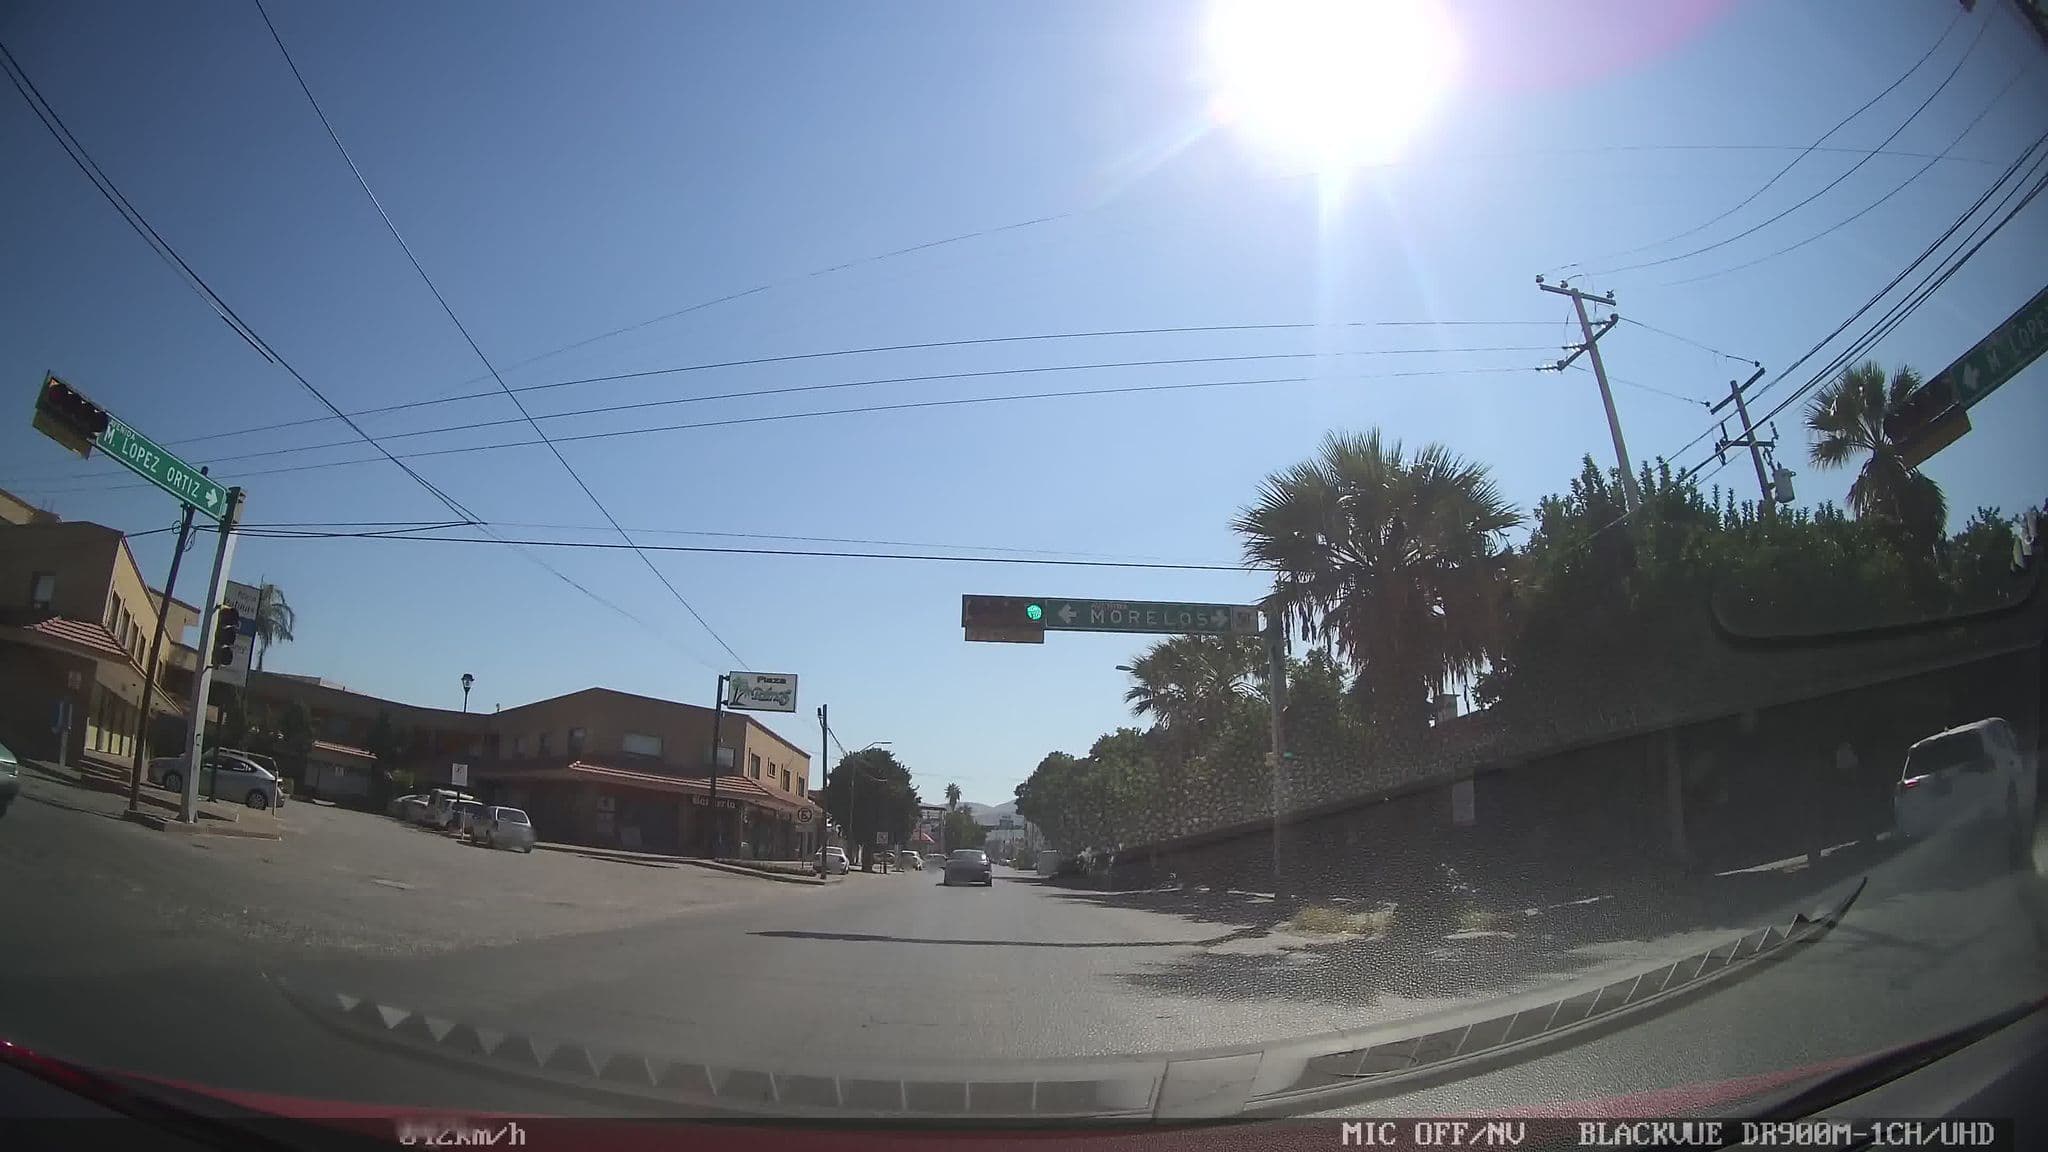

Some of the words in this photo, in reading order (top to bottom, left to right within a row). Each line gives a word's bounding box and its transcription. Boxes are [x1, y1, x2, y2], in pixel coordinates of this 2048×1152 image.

[122, 437, 160, 473] LOPEZ
[167, 466, 200, 498] ORTIZ
[1090, 608, 1209, 627] MORELOS
[757, 675, 787, 685] Plaza
